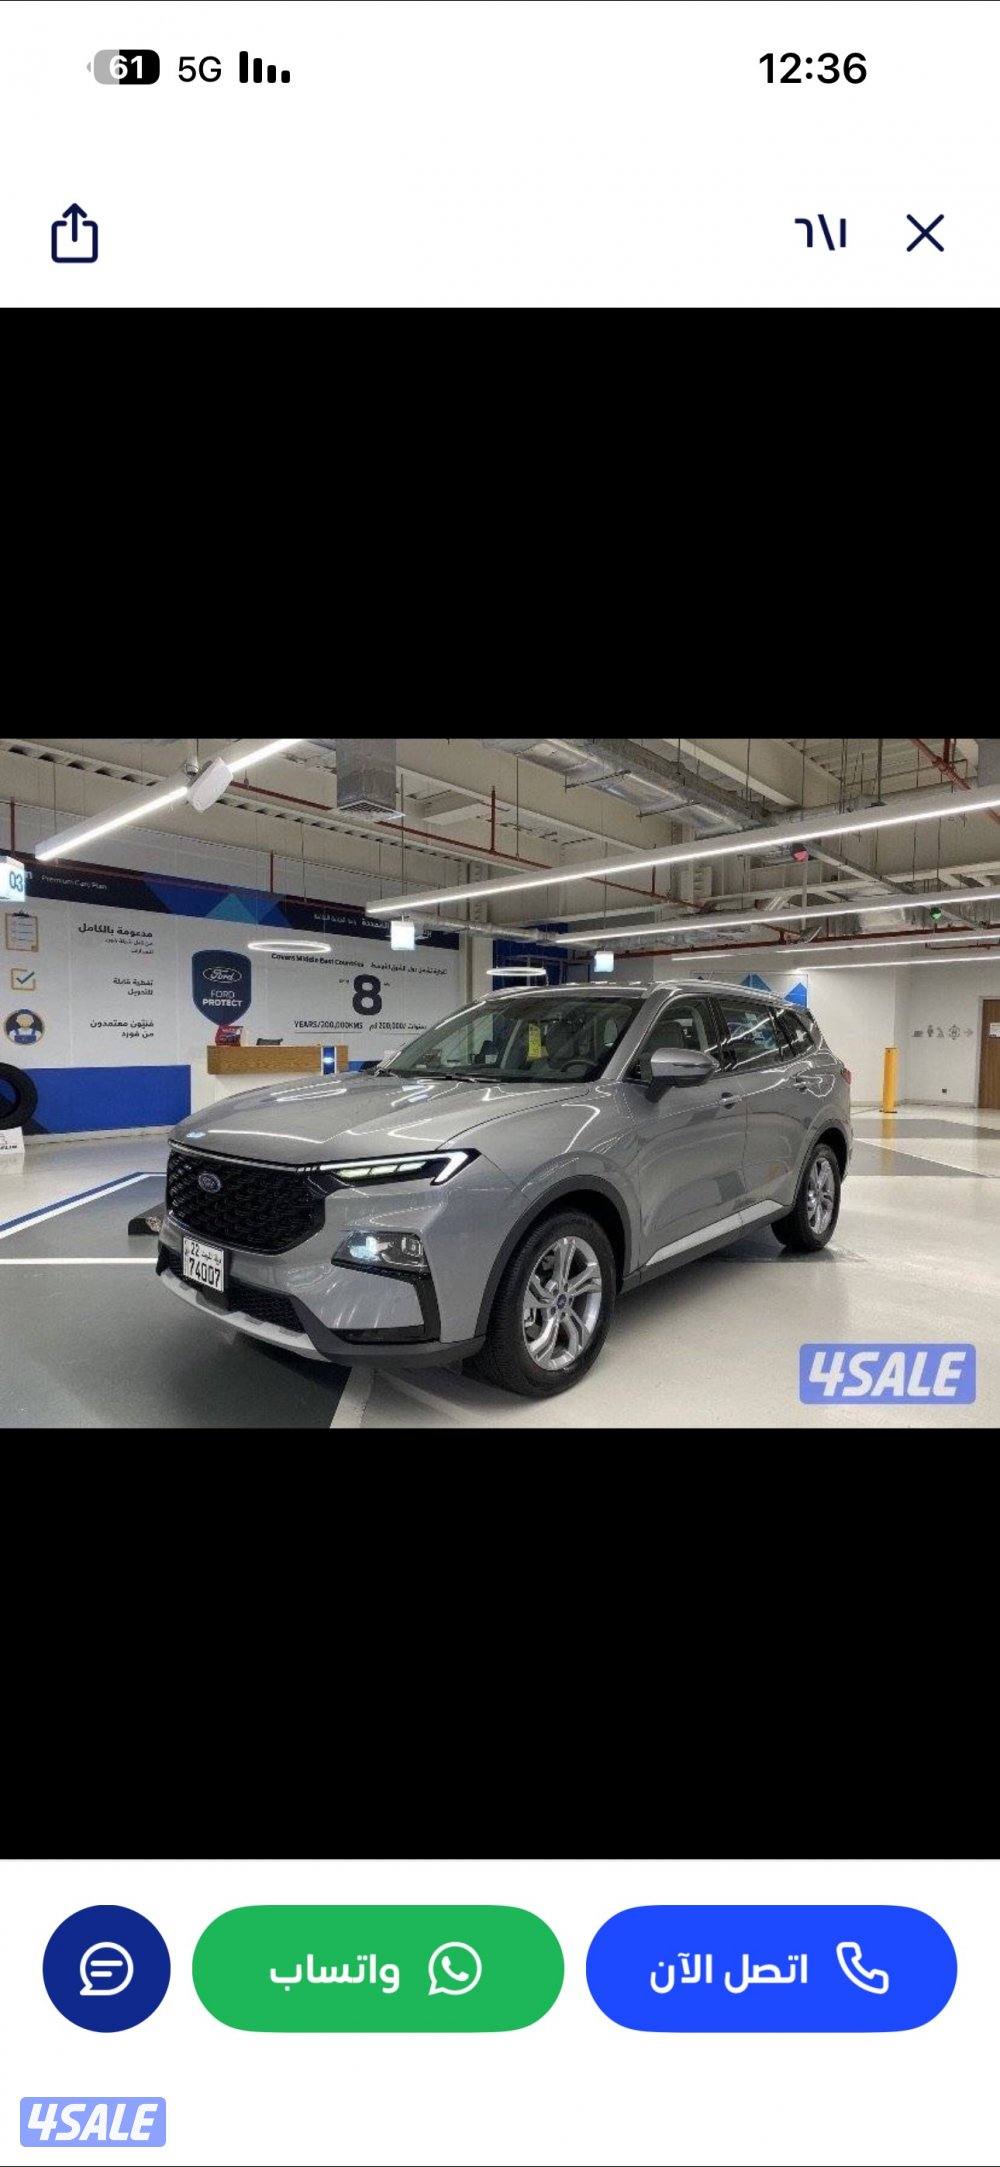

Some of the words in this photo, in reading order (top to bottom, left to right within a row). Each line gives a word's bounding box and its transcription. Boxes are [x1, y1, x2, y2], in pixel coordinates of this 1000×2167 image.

[110, 56, 146, 80] 61
[179, 56, 221, 82] 5G
[760, 53, 866, 84] 12:36
[9, 871, 24, 893] 03
[78, 923, 114, 936] بالكامل
[202, 998, 243, 1006] PROTECT
[210, 990, 235, 998] FORD
[352, 974, 382, 1015] 8
[191, 1241, 200, 1257] 22
[189, 1256, 220, 1287] 74007
[271, 1953, 400, 1994] واتساب
[650, 1953, 712, 1994] الآن
[724, 1953, 808, 1994] اتصل
